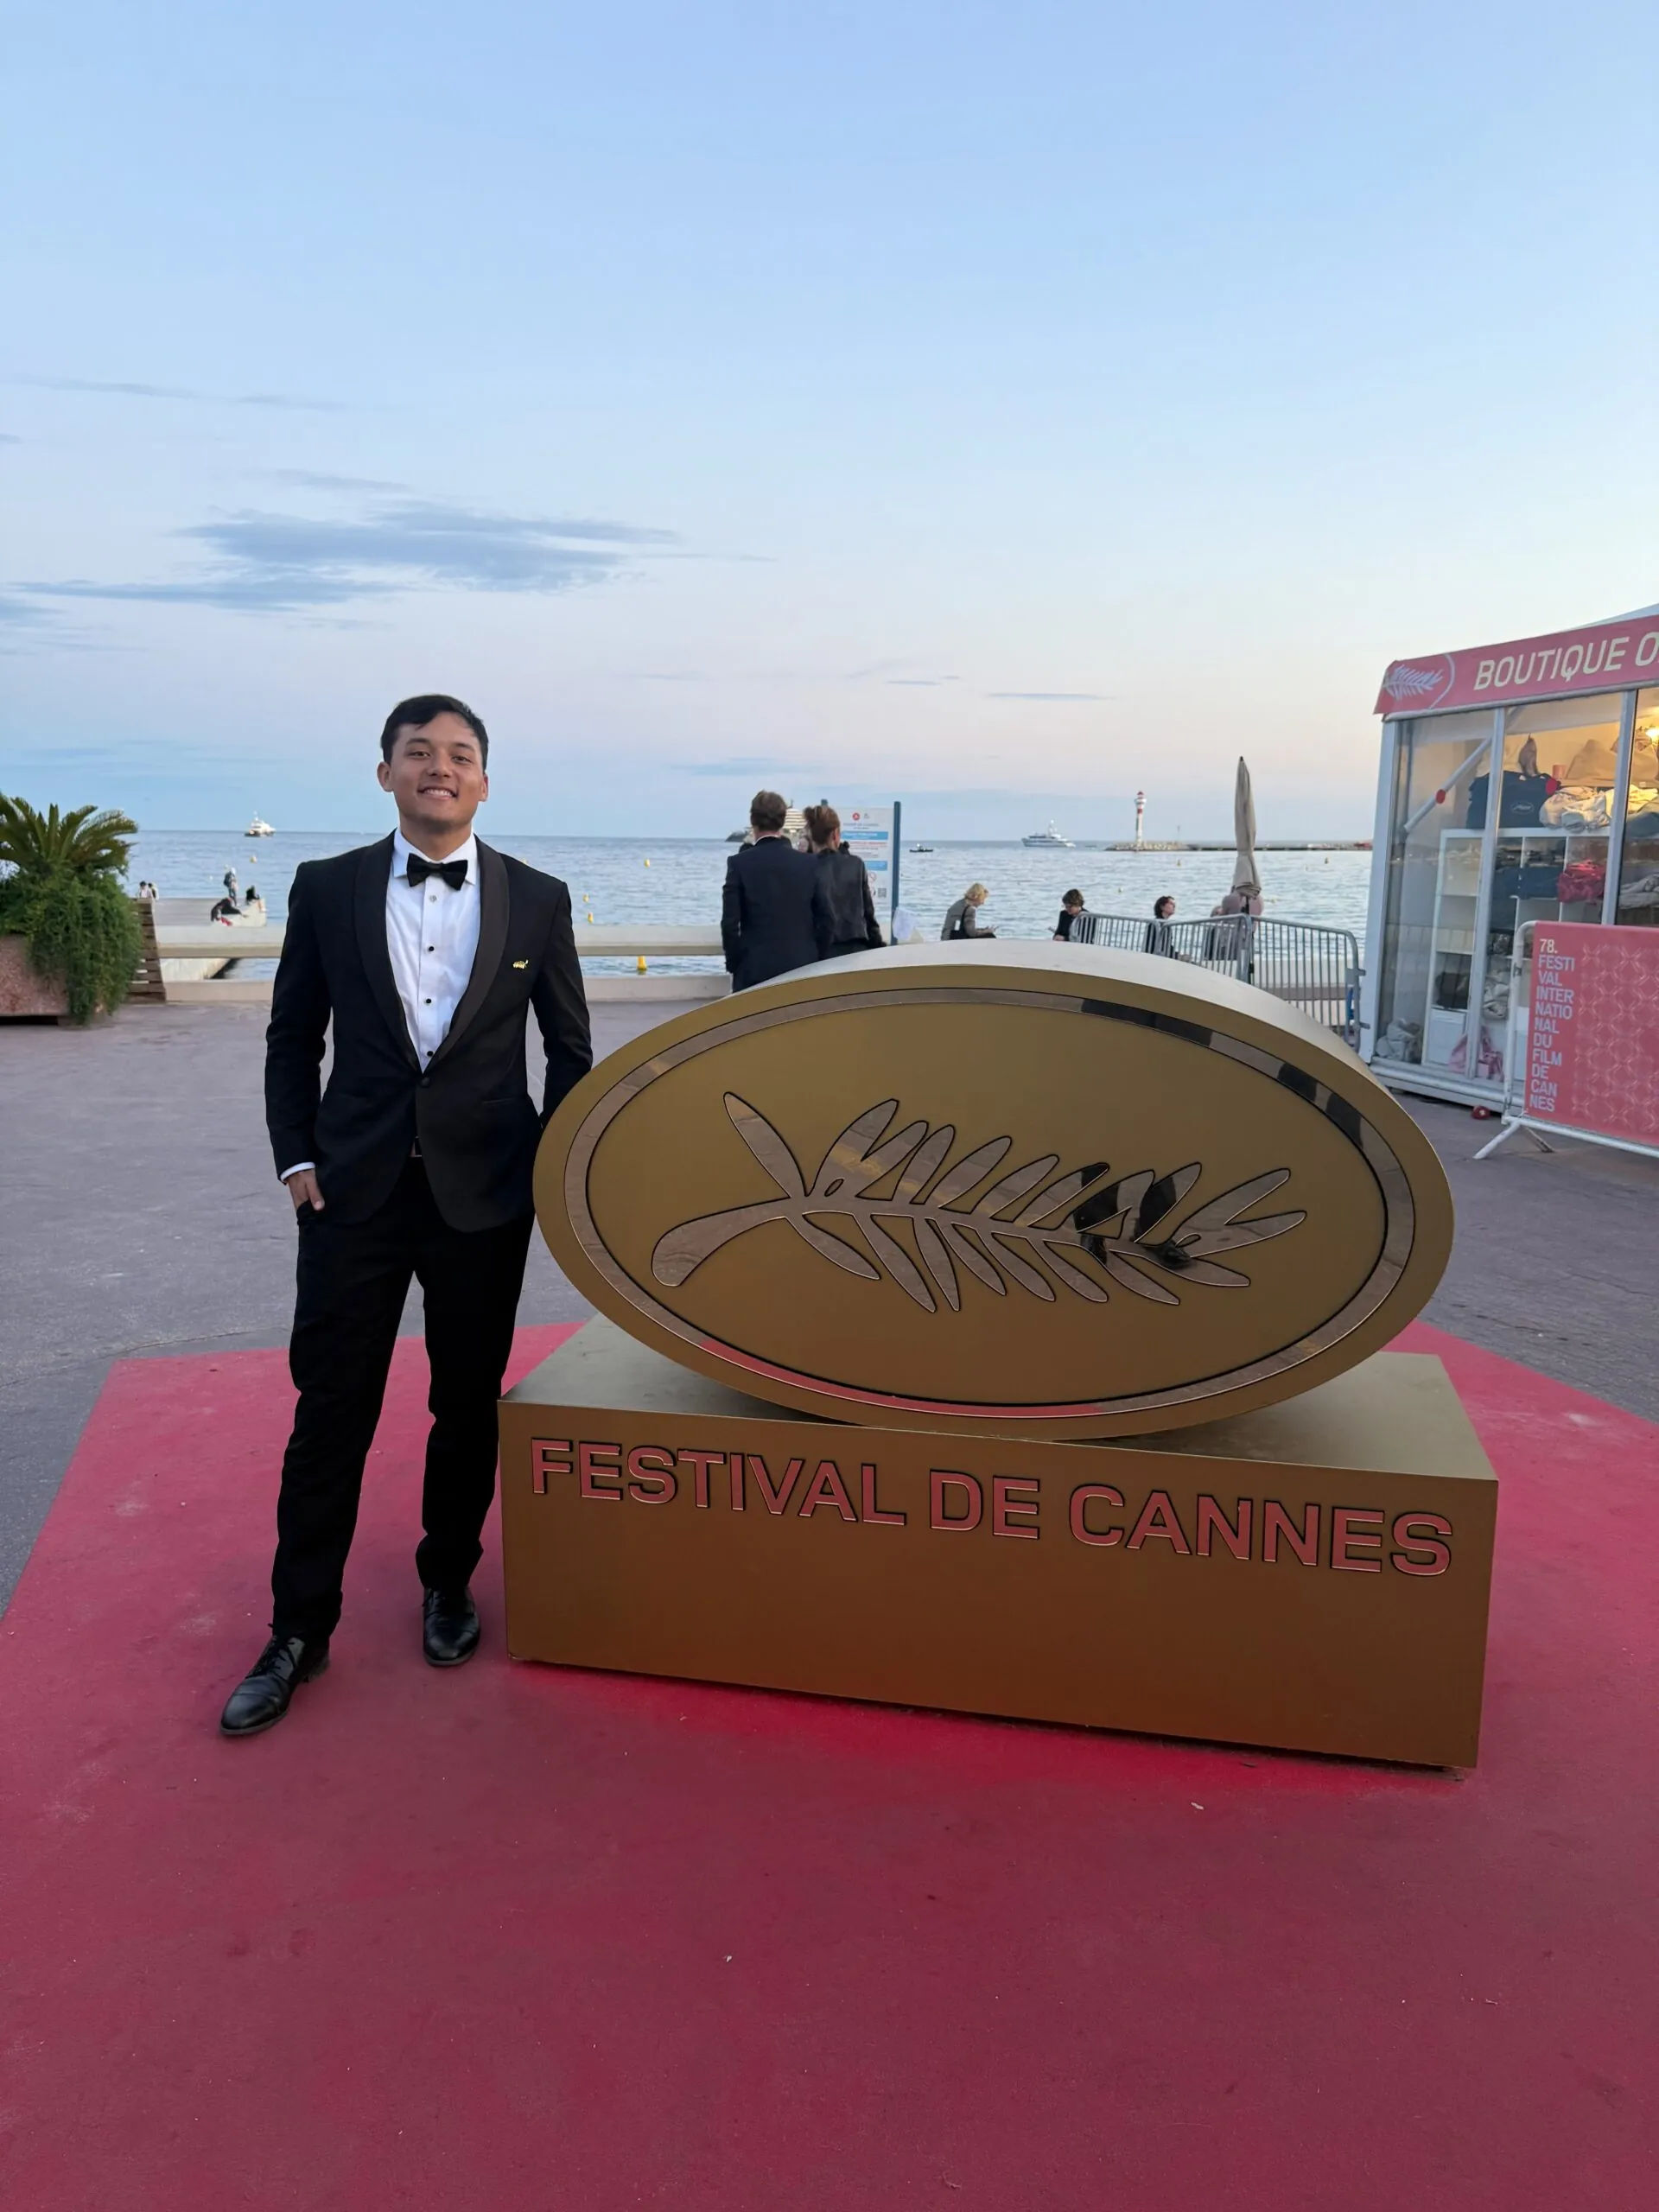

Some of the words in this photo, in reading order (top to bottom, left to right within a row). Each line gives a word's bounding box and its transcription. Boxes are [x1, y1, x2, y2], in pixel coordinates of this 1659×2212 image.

[1473, 636, 1630, 690] BOUTIQUE
[1539, 938, 1558, 954] 78.
[1538, 954, 1575, 972] FESTI
[1538, 970, 1563, 987] VAL
[1536, 986, 1574, 1004] INTER
[1535, 1001, 1573, 1020] NATIO
[1534, 1016, 1560, 1034] NAL
[1533, 1032, 1553, 1049] DU
[1532, 1048, 1562, 1066] FILM
[1531, 1063, 1550, 1080] DE
[1530, 1078, 1558, 1097] CAN
[1529, 1093, 1555, 1112] NES
[531, 1437, 906, 1526] FESTIVAL
[929, 1469, 1040, 1541] DE
[1068, 1484, 1453, 1577] CANNES
